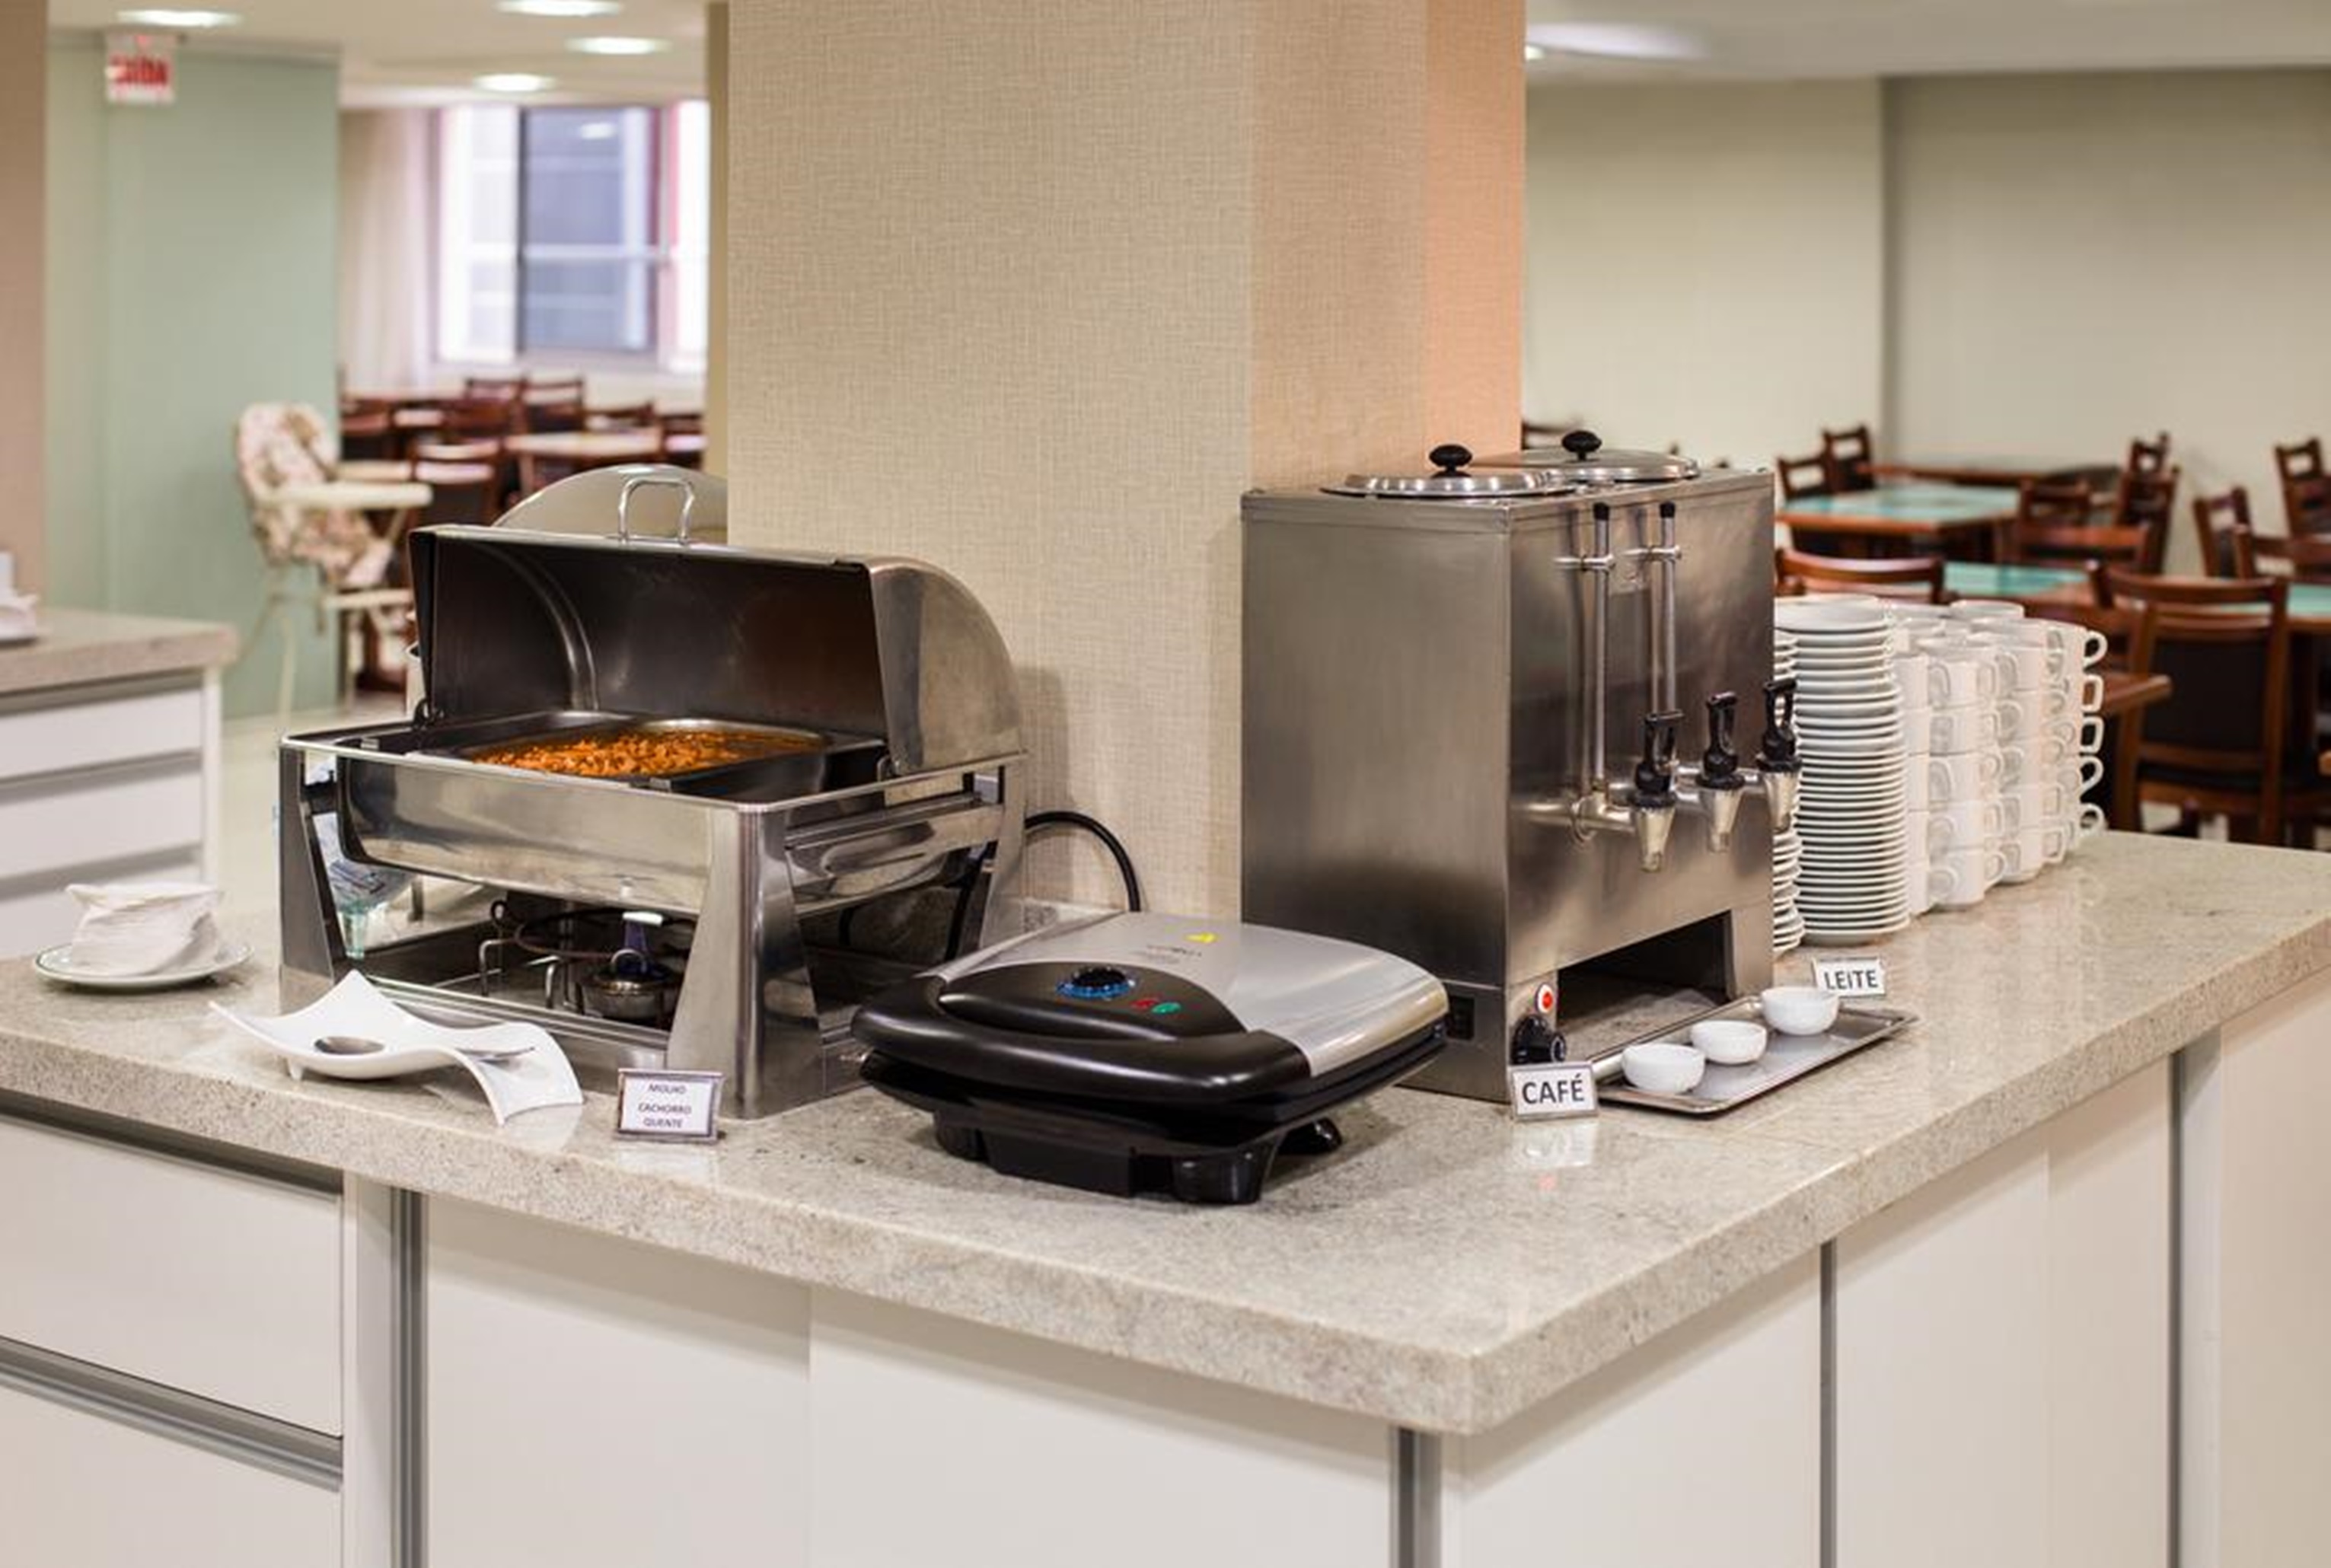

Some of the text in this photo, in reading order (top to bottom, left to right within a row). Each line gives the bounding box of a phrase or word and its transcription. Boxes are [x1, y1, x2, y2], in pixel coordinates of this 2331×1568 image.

[1824, 970, 1878, 990] LEITE
[649, 1084, 687, 1094] MOLHO
[1523, 1073, 1584, 1104] CAFÉ
[638, 1103, 692, 1115] CACHORRO
[643, 1118, 684, 1128] QUENTE
